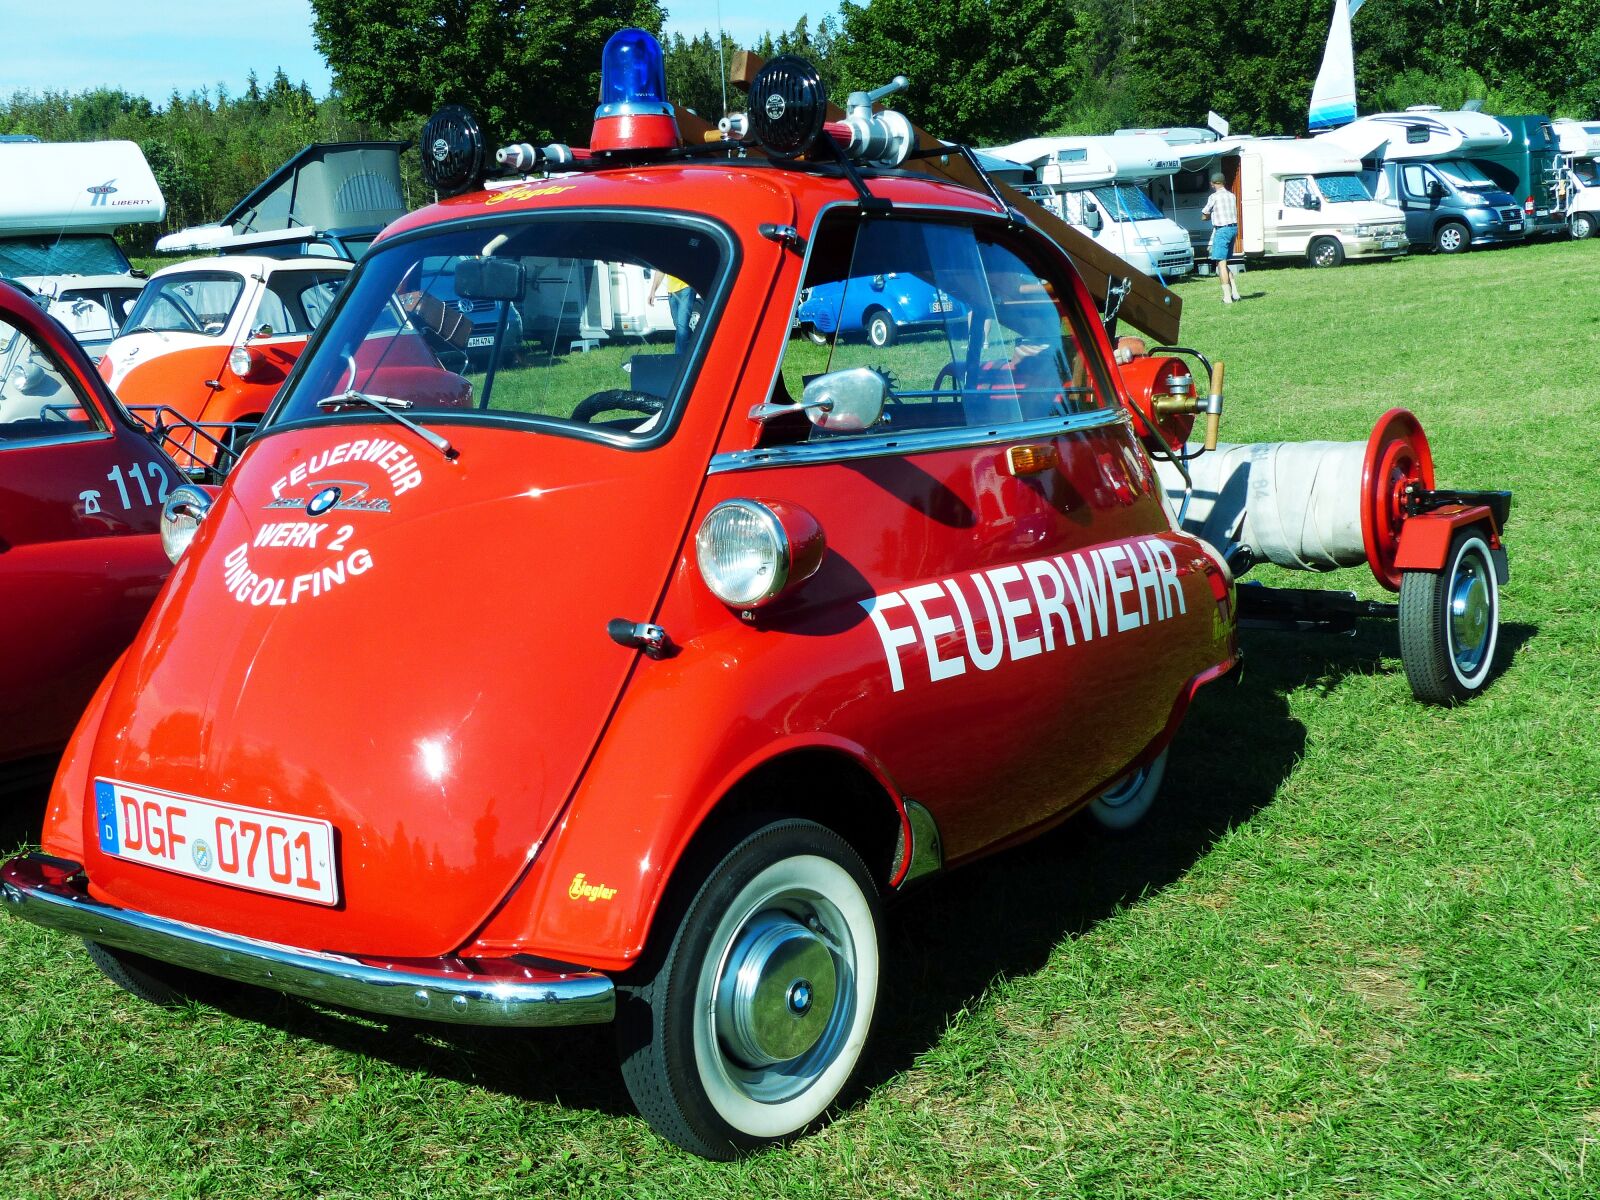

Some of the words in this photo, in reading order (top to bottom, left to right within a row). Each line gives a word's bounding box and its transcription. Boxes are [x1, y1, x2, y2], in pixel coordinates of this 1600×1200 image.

[107, 461, 169, 510] 112
[271, 438, 423, 498] FEUERWEHR
[253, 522, 329, 549] WERK
[327, 525, 354, 551] 2
[223, 542, 374, 606] DINGOLFING
[857, 539, 1187, 693] FEUERWEHR
[104, 824, 113, 841] D
[120, 795, 187, 860] DGF
[214, 816, 321, 891] 0701
[568, 872, 618, 902] Ziegler
